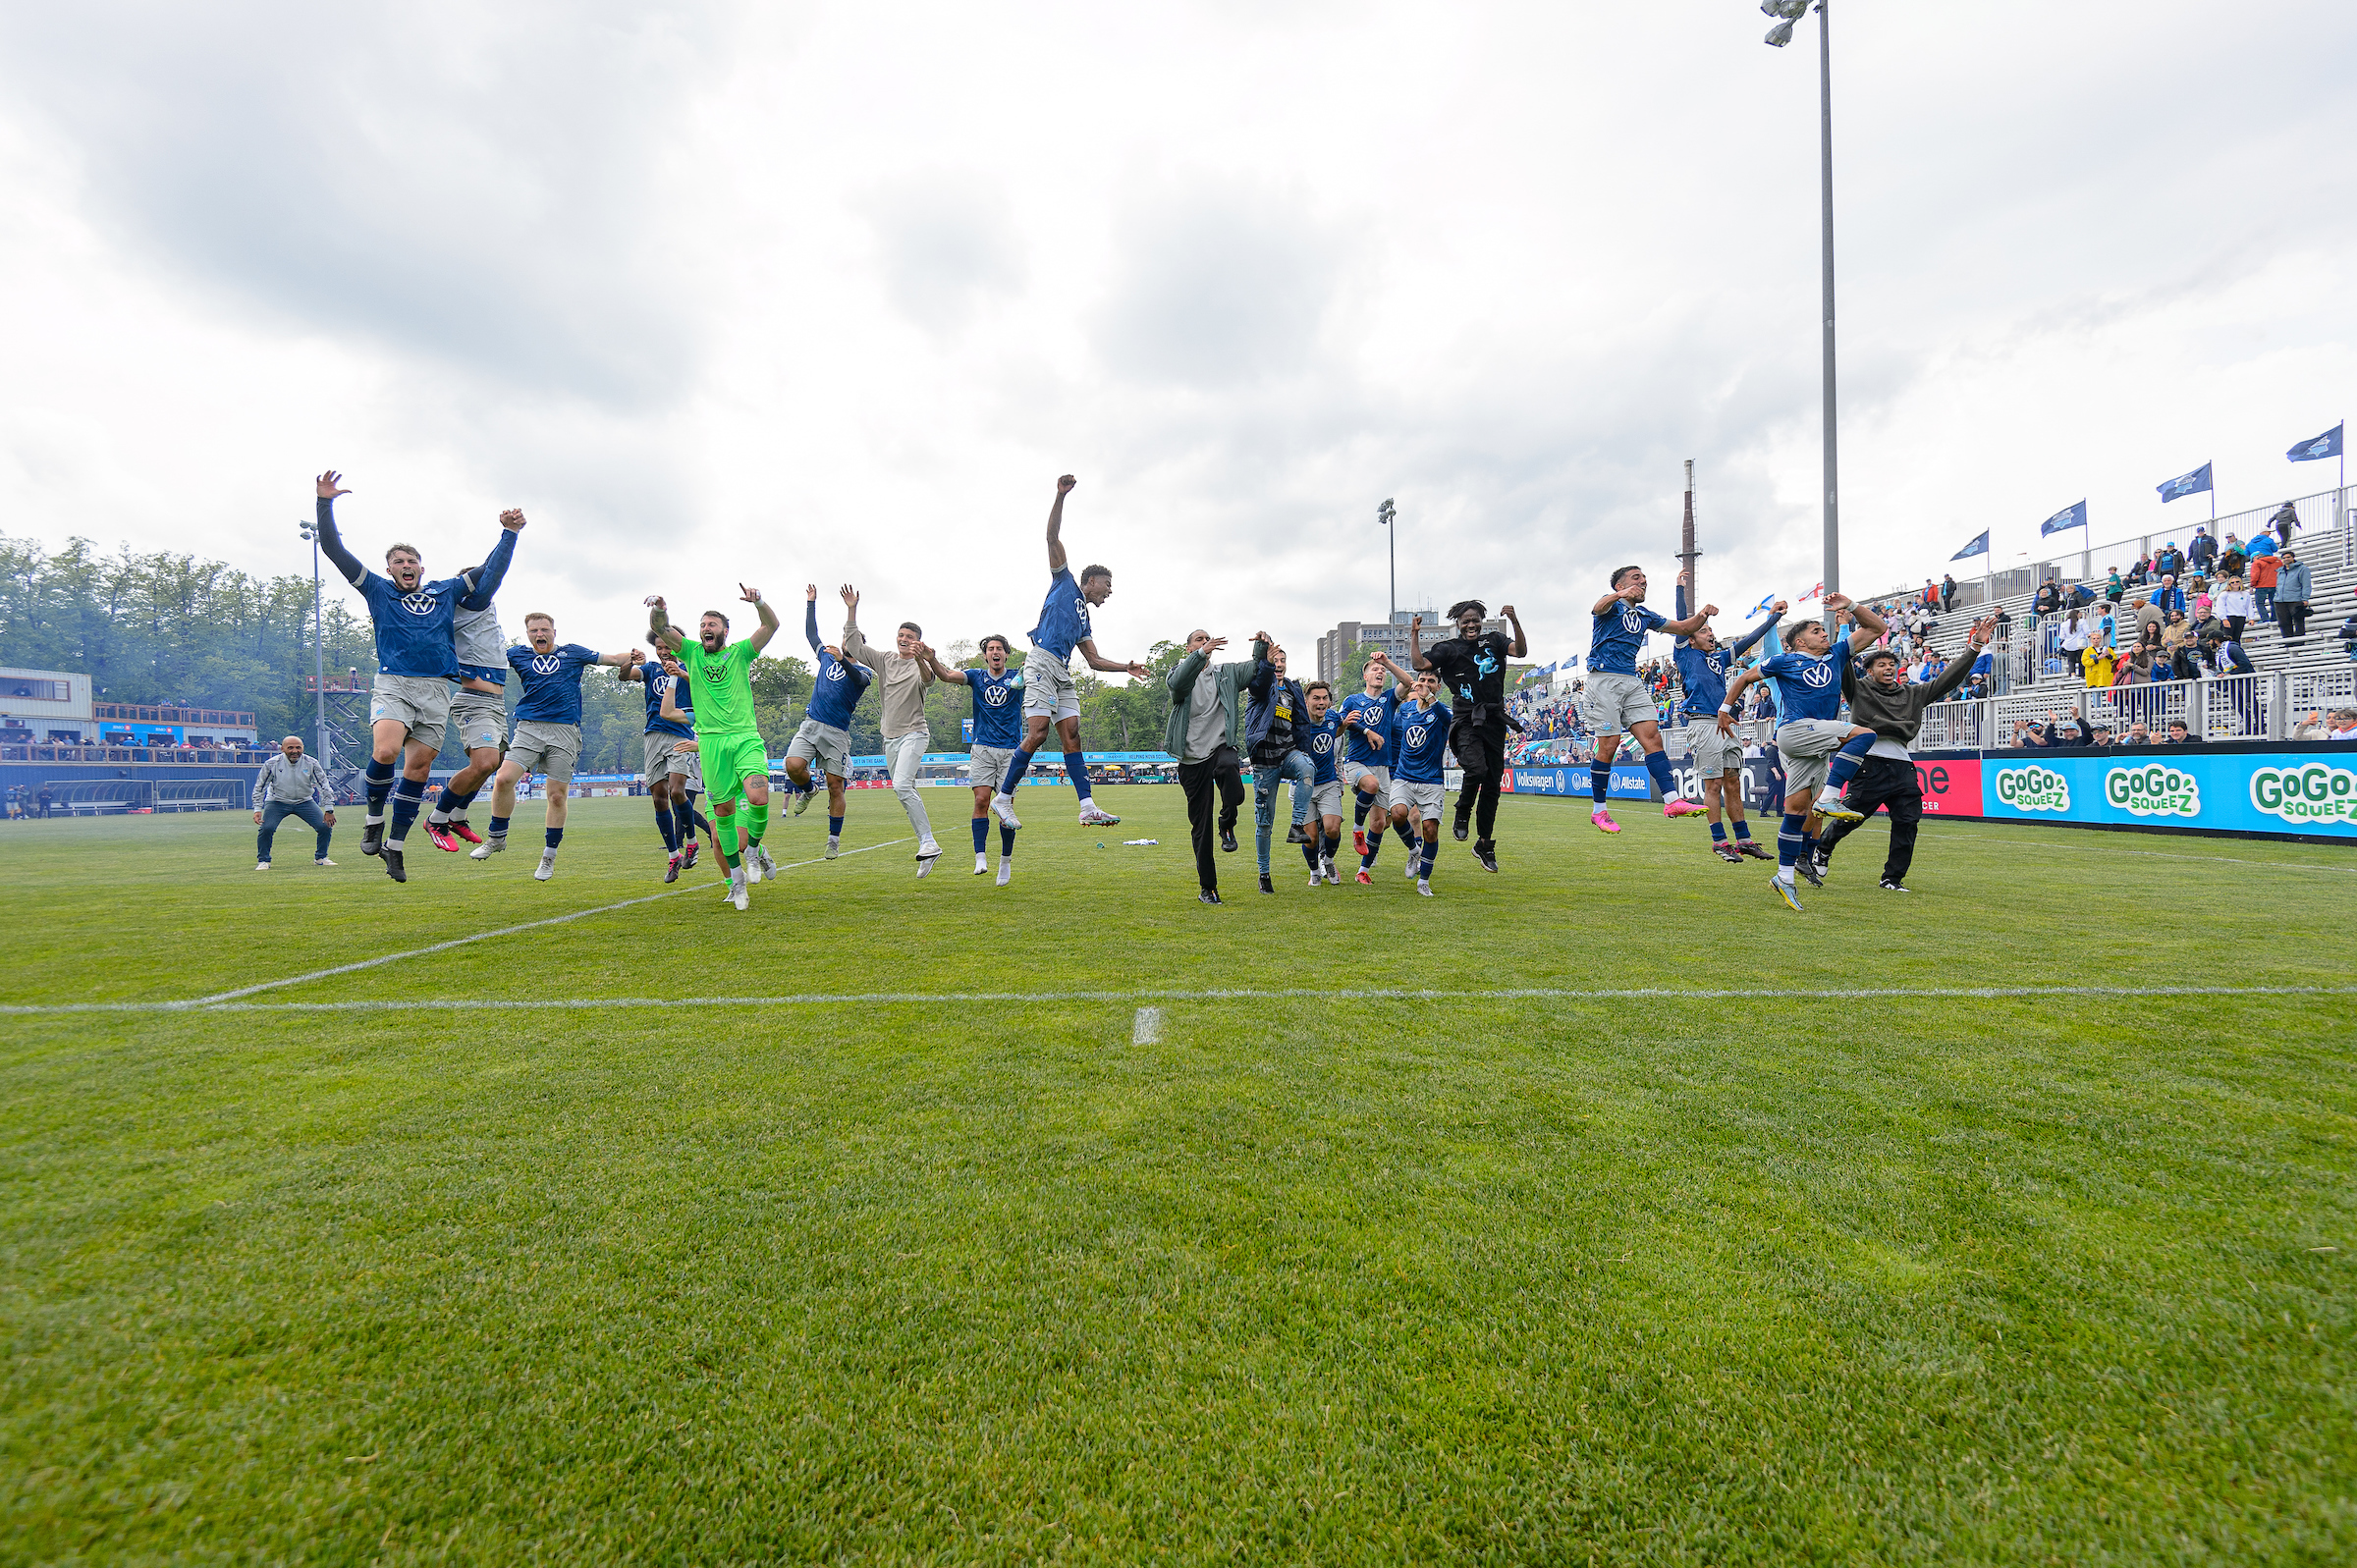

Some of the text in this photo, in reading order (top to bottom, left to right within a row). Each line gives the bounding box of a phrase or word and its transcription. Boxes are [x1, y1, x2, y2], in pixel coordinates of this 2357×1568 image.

[402, 592, 436, 616] VW
[532, 654, 560, 675] VW
[1802, 662, 1833, 688] VW
[985, 684, 1007, 706] VW
[1363, 706, 1384, 727] VW
[1313, 732, 1334, 754] VW
[1406, 726, 1427, 748] VW
[1515, 771, 1555, 792] Volkswagen
[1916, 766, 1950, 794] ne
